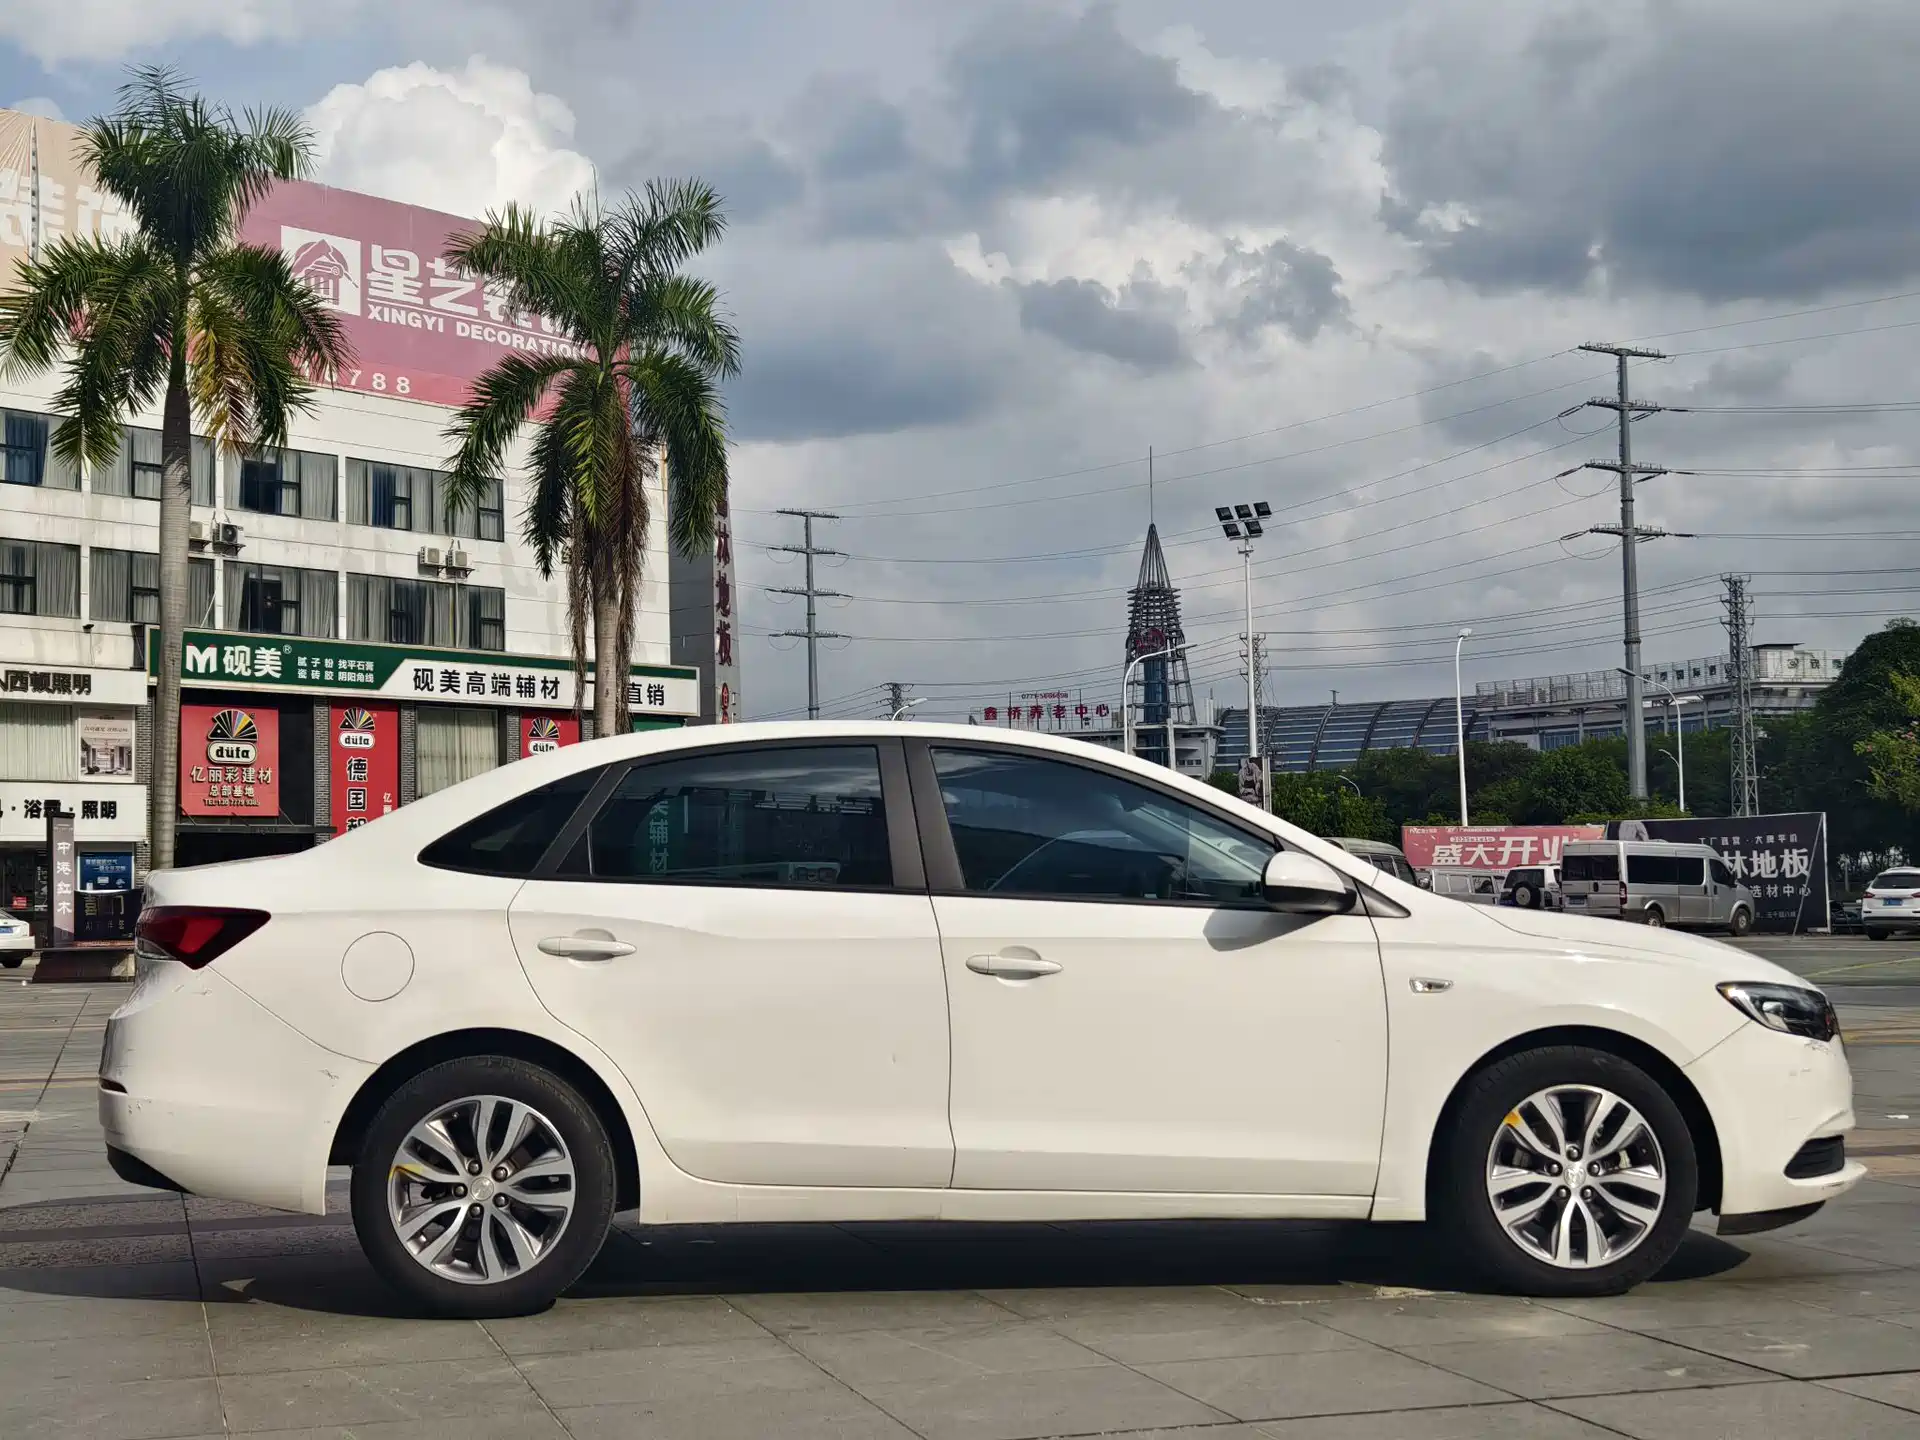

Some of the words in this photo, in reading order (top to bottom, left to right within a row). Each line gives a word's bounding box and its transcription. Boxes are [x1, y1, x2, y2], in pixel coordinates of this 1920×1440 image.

[367, 304, 444, 333] XINGYI
[456, 321, 588, 357] DECORATION
[222, 645, 282, 679] 砚美
[412, 667, 560, 700] 砚美高端辅材
[984, 703, 1110, 721] 鑫桥养老中心
[344, 735, 369, 746] düfa
[215, 746, 250, 759] düfa
[190, 765, 272, 784] 亿丽彩建材
[209, 785, 254, 798] 总部基地
